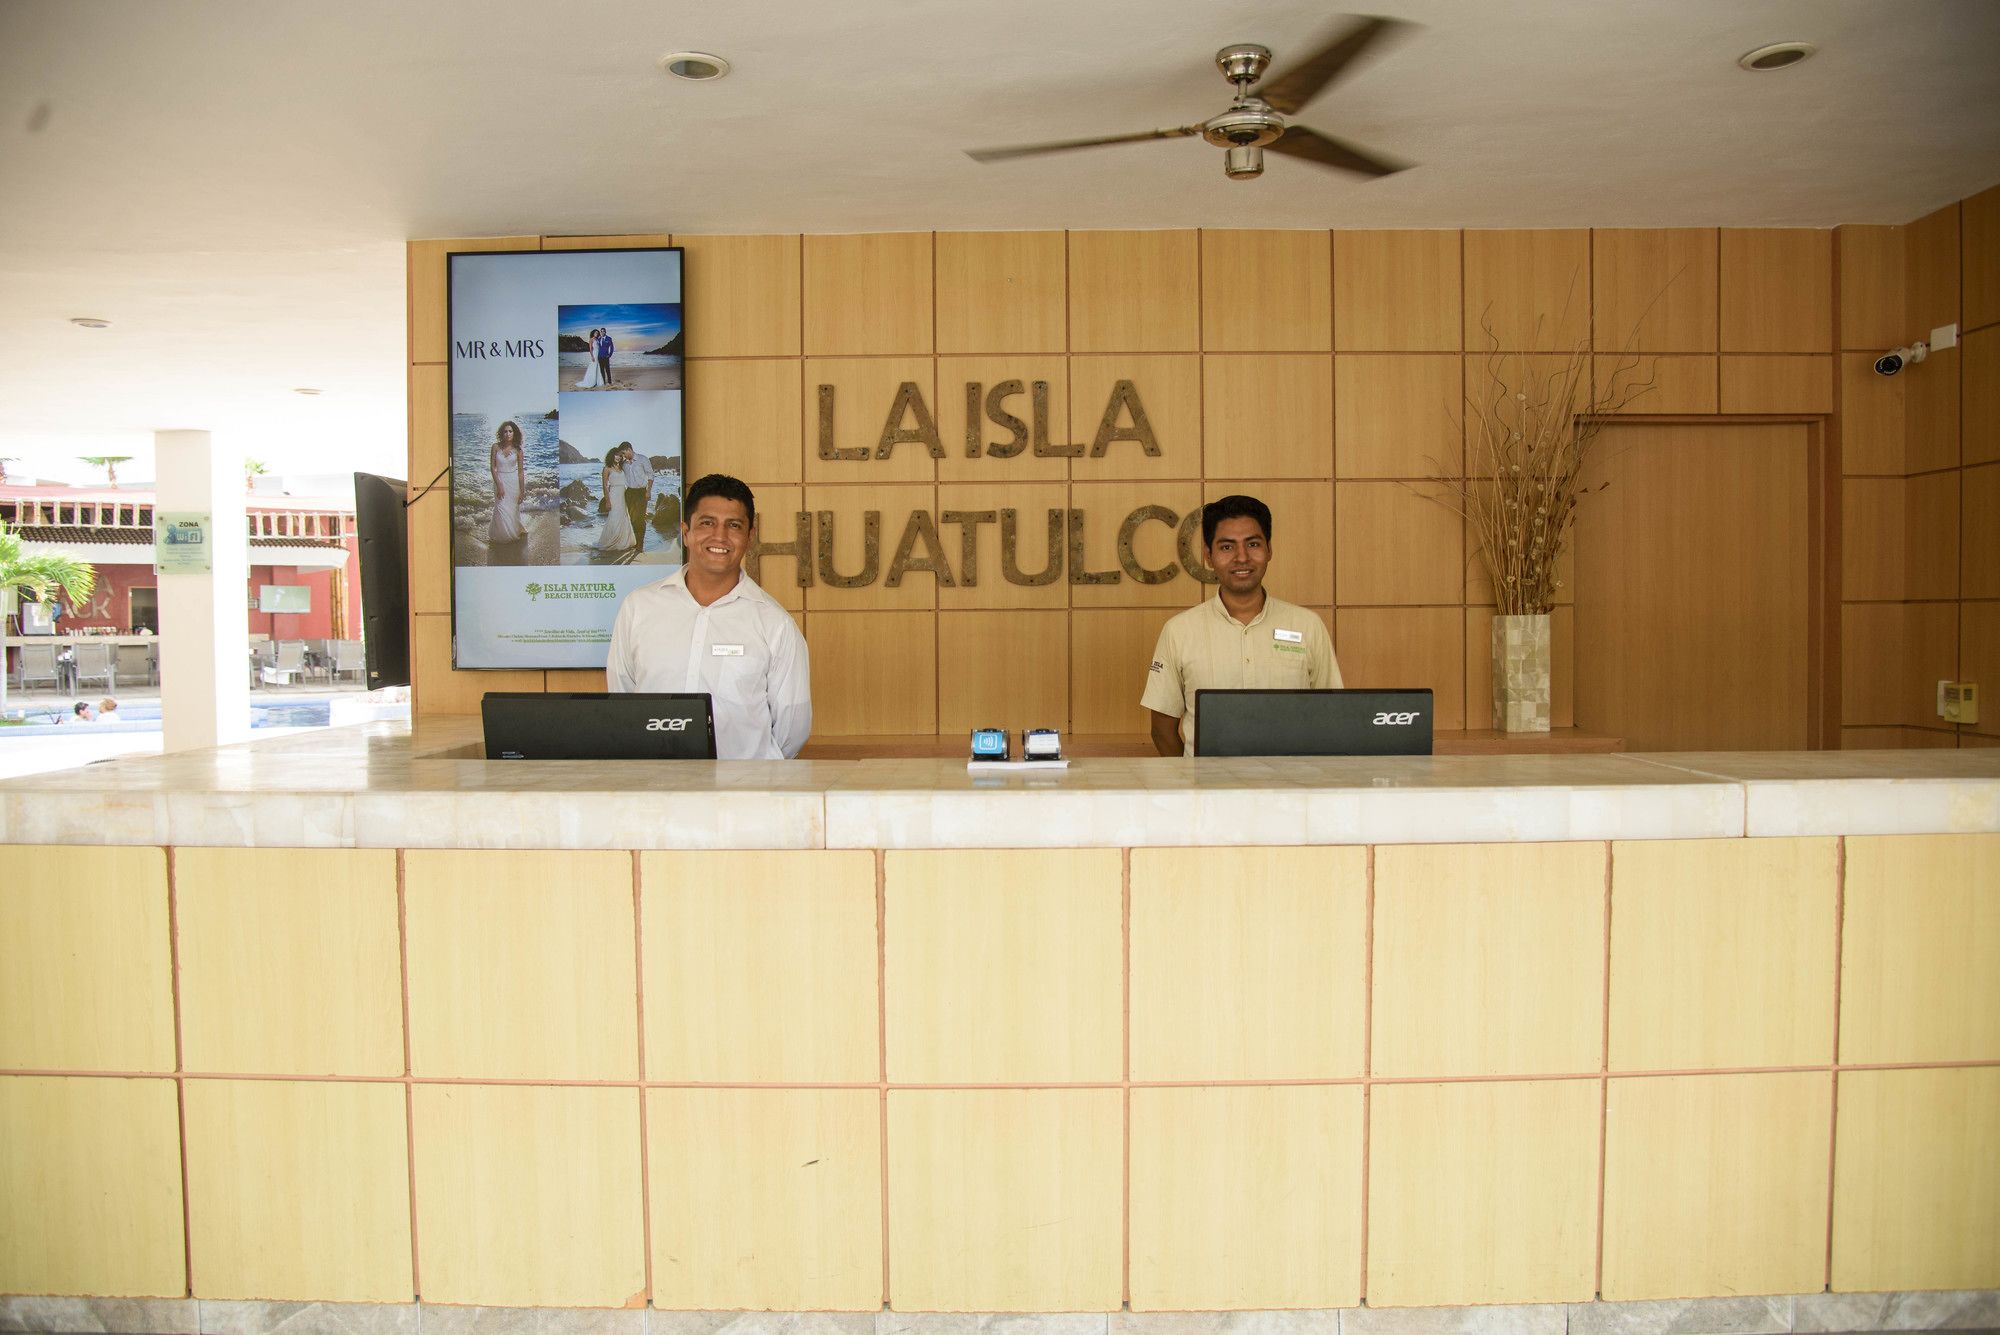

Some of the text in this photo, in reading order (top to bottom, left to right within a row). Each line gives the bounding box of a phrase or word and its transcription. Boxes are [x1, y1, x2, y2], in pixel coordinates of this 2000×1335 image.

[456, 339, 545, 360] MR & MRS
[818, 379, 1162, 461] LA ISLA
[543, 583, 616, 592] ISLA NATURA
[646, 718, 693, 731] acer
[1372, 712, 1420, 725] acer
